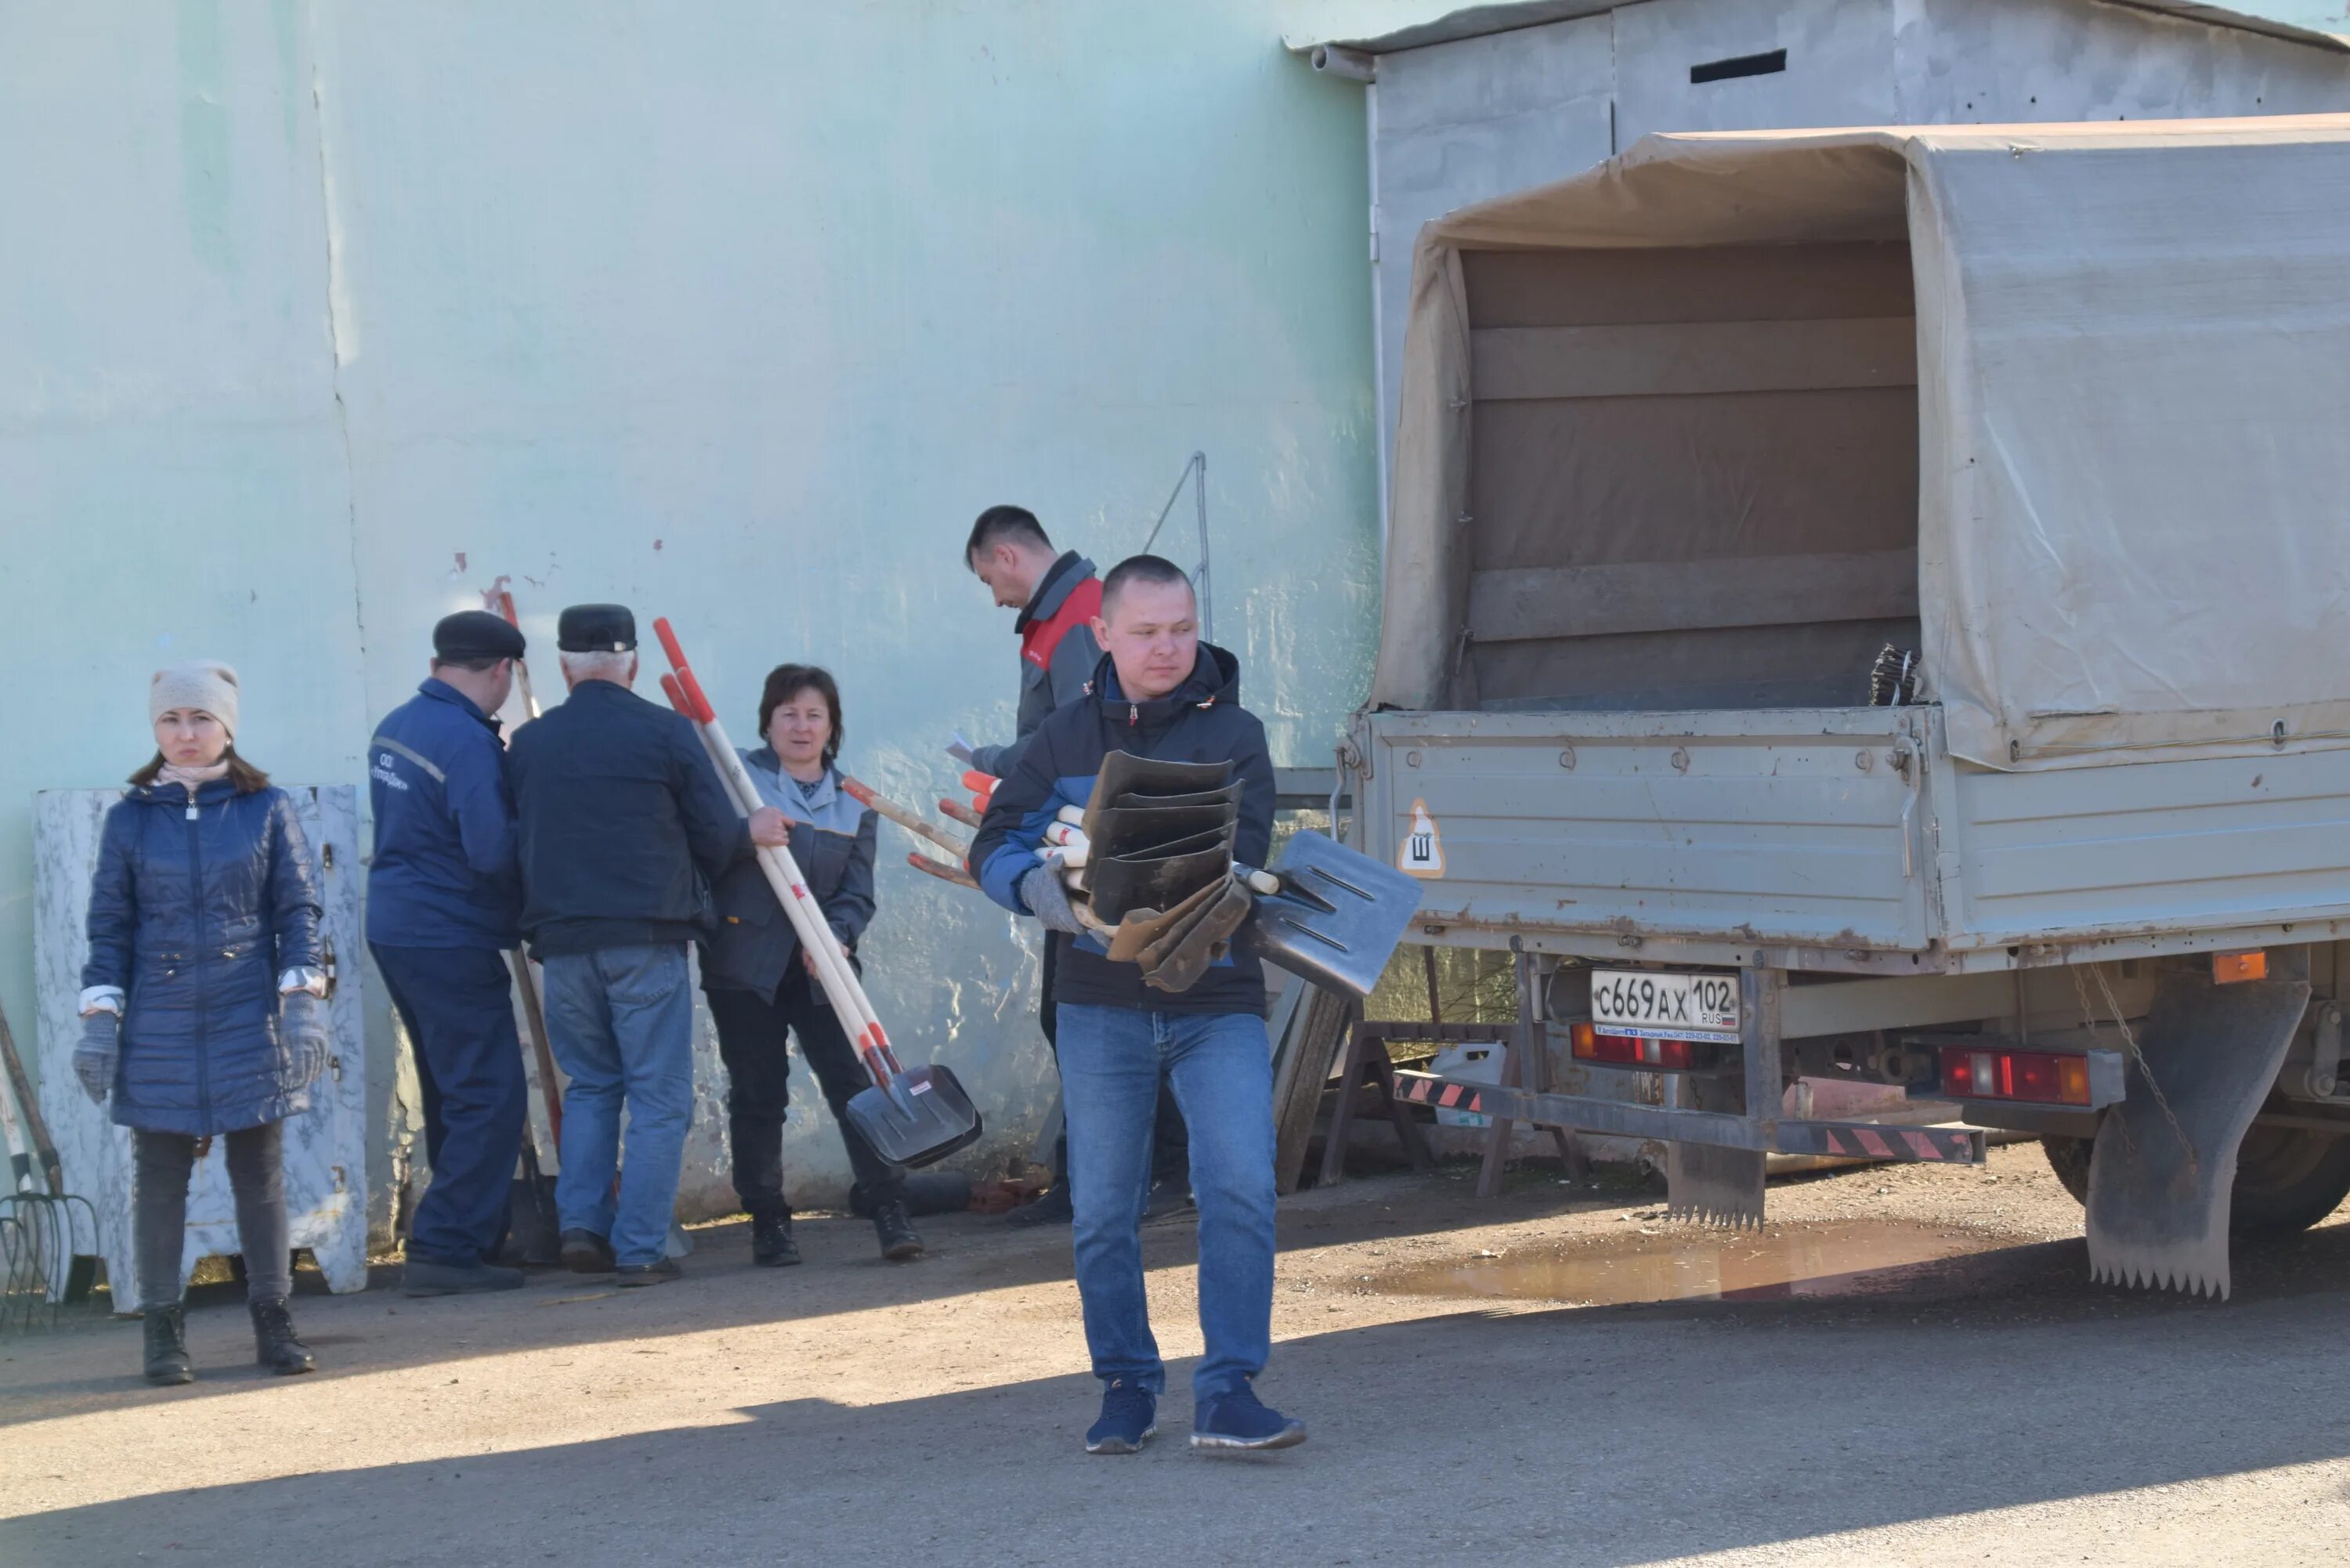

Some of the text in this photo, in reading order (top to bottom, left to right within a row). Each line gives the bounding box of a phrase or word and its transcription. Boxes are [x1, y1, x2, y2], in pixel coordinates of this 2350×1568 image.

[1412, 836, 1430, 861] Ш
[1599, 977, 1730, 1021] С669АХ 102
[1701, 1013, 1722, 1024] RUS
